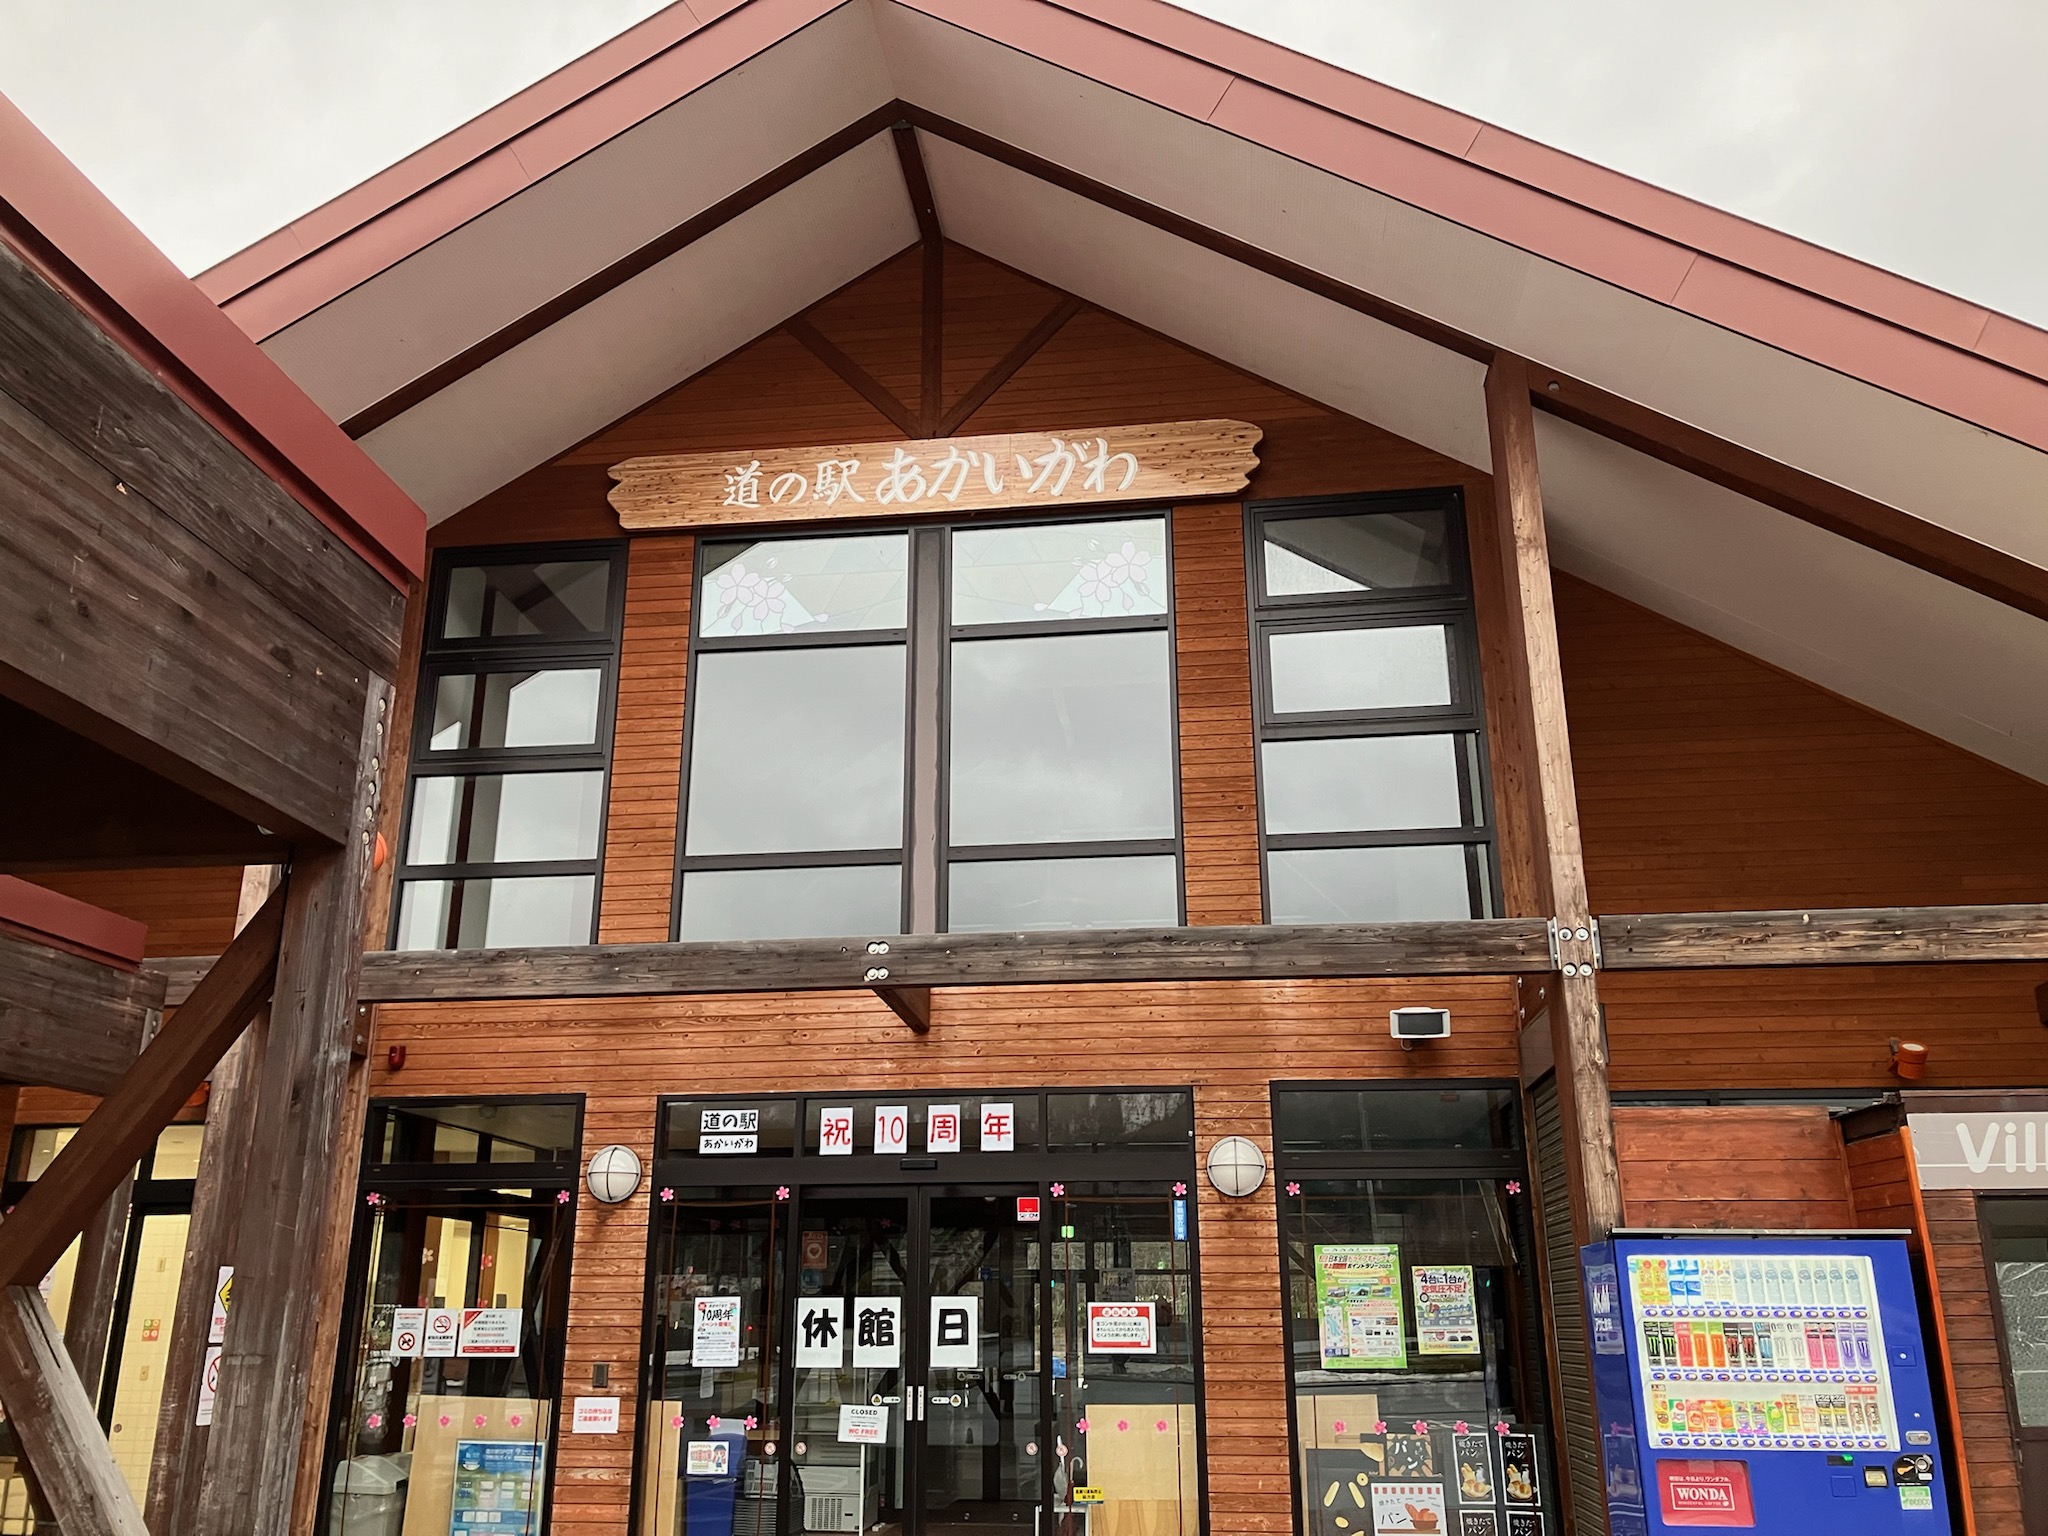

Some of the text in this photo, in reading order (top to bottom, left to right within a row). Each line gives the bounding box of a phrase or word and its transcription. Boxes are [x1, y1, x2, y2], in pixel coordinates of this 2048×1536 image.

[703, 1112, 757, 1130] 道の駅
[703, 1137, 754, 1149] あかいがわ
[1956, 1121, 2048, 1174] Vil
[1420, 1272, 1465, 1284] 4台に1台が
[701, 1309, 734, 1321] 10周年
[850, 1408, 878, 1416] CLOSED
[1458, 1440, 1484, 1449] 焼きたて
[1460, 1449, 1479, 1458] パン
[1507, 1449, 1525, 1459] パン
[1676, 1487, 1728, 1501] WONDA
[1378, 1498, 1402, 1507] 焼きたて
[1381, 1512, 1407, 1525] パン
[1465, 1517, 1492, 1526] 焼きたて
[1467, 1526, 1487, 1535] パン
[1514, 1528, 1533, 1536] パン
